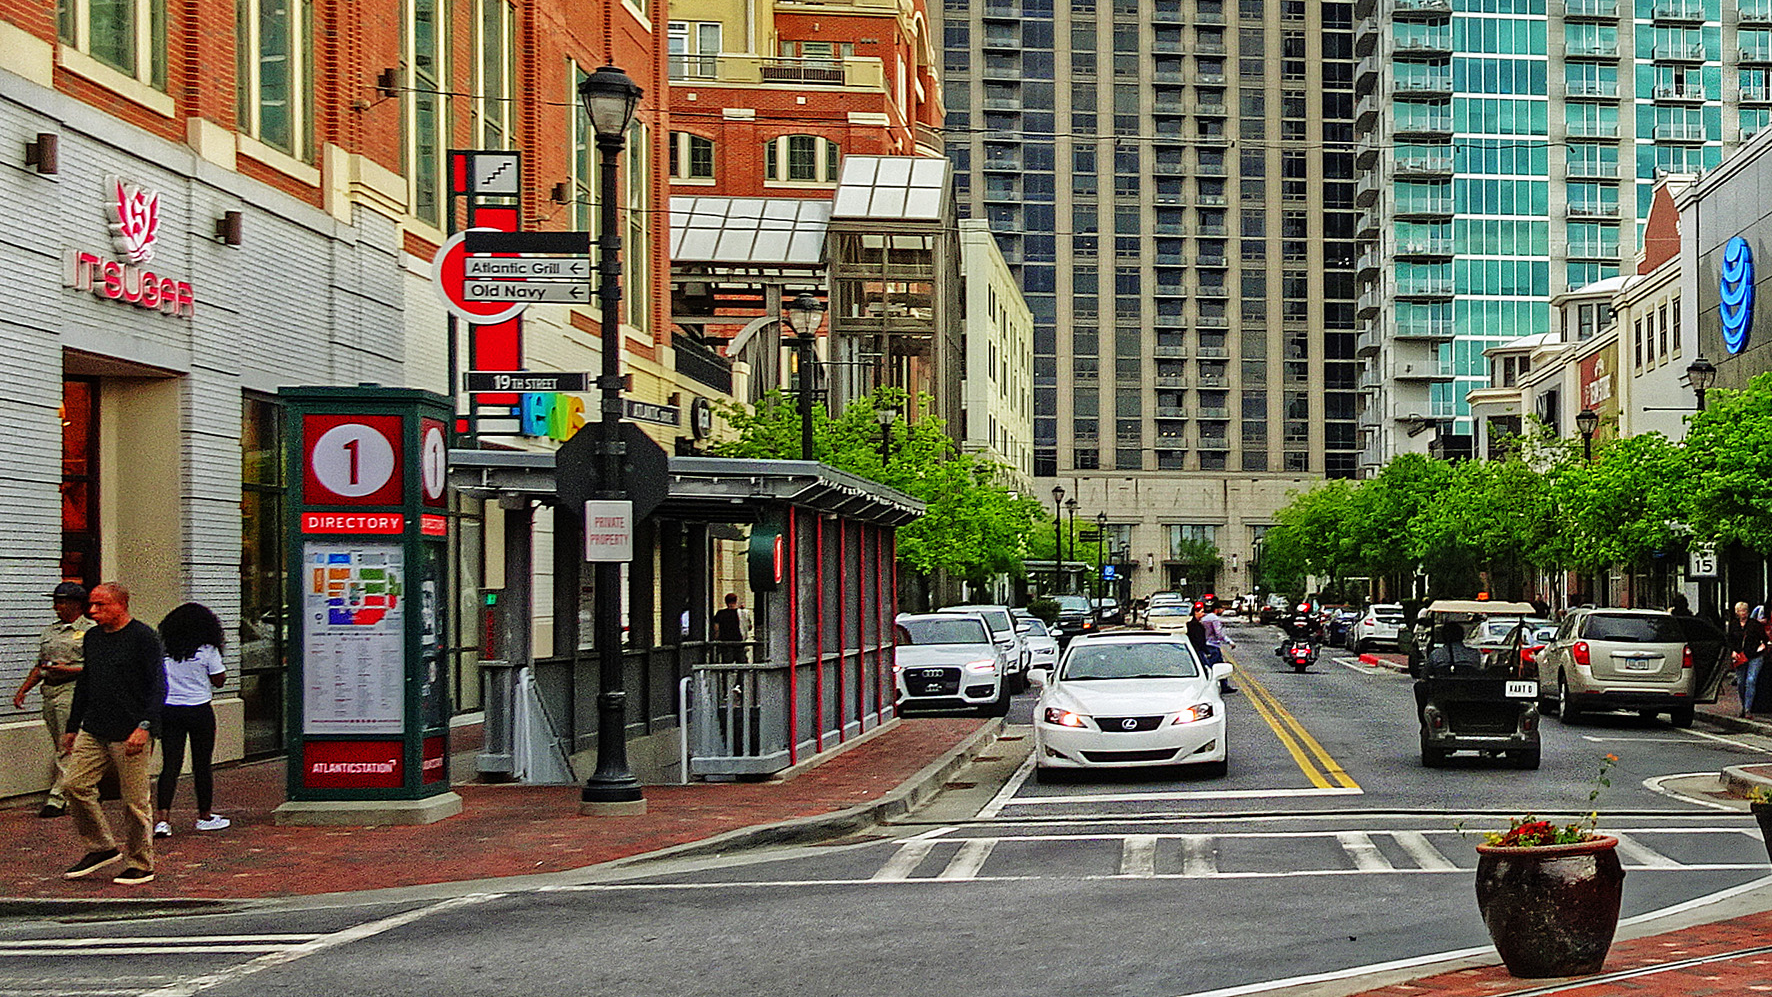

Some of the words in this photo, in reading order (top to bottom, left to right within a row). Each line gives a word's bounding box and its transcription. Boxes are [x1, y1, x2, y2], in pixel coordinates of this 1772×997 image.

[471, 262, 527, 274] Atlantic
[532, 262, 560, 274] Grill
[471, 284, 499, 297] Old
[505, 285, 546, 300] Navy
[525, 378, 558, 390] STREET
[343, 438, 360, 485] 1
[432, 443, 439, 488] 1
[308, 517, 400, 529] DIRECTORY
[594, 516, 625, 529] PRIVATE
[590, 533, 629, 546] PROPERTY
[1695, 559, 1714, 573] 15
